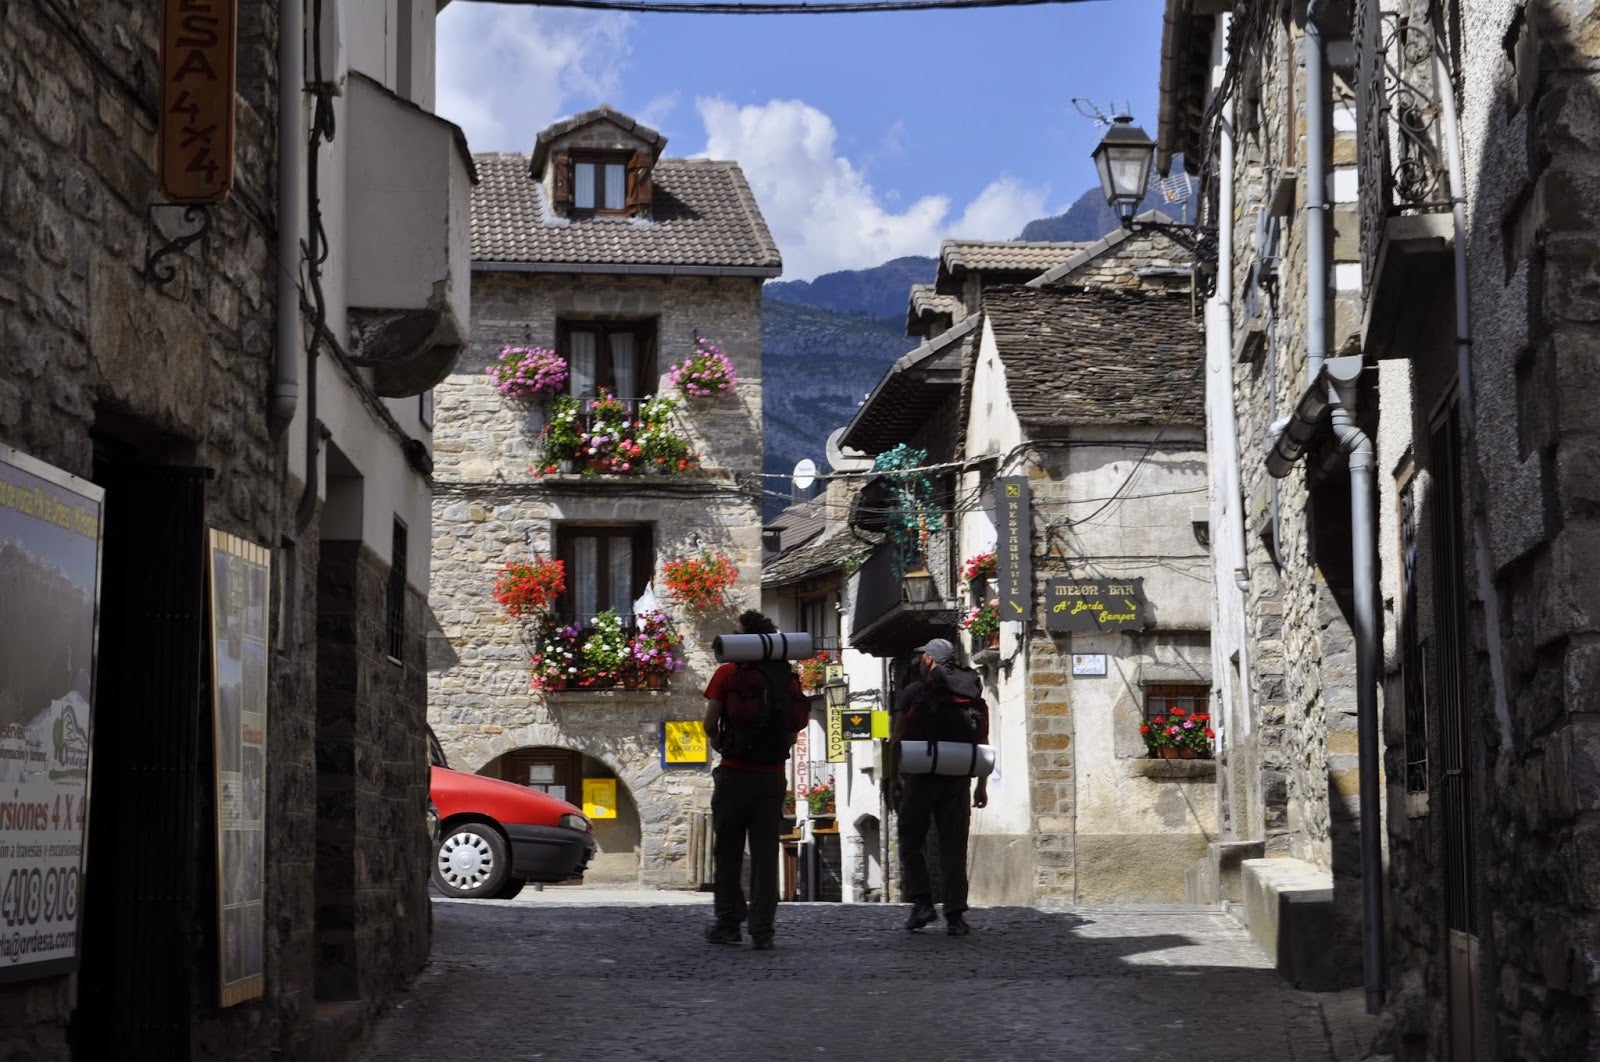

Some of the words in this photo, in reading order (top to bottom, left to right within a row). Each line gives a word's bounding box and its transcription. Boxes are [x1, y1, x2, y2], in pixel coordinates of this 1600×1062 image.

[1007, 501, 1020, 595] RESTAURANTE
[1107, 584, 1135, 596] BAR
[1070, 600, 1105, 615] Borda
[1098, 609, 1136, 624] Samper
[52, 794, 61, 831] 4
[2, 867, 42, 927] 418
[44, 866, 78, 923] 918
